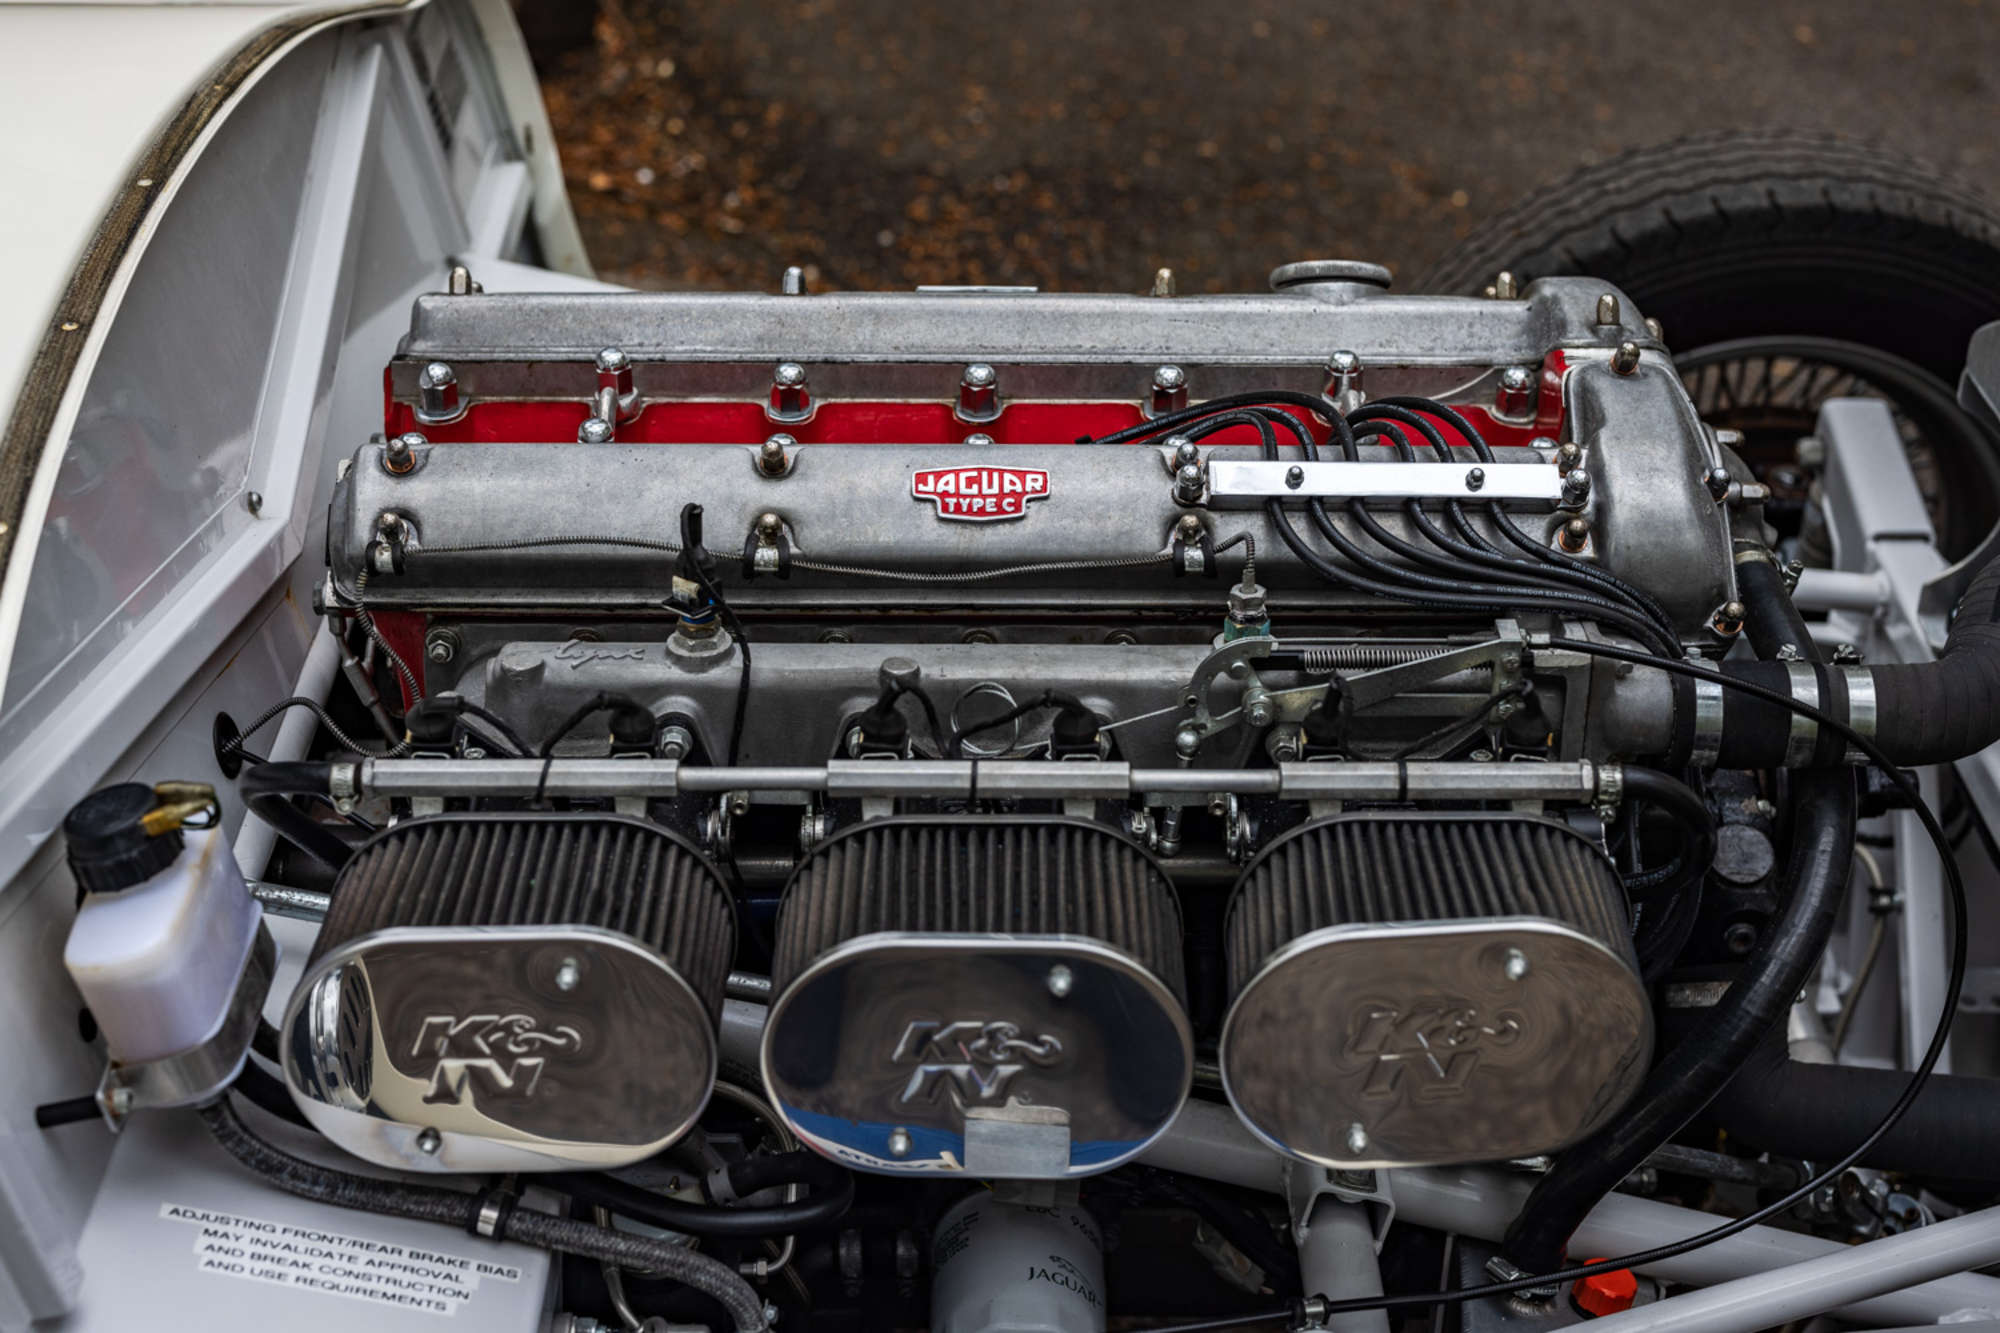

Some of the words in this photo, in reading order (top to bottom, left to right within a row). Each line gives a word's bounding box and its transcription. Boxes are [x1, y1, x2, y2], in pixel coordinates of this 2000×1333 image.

[917, 470, 1044, 496] JAGUAR
[944, 497, 998, 512] TYPE
[1002, 498, 1015, 511] C
[168, 1207, 276, 1234] ADJUSTING
[281, 1226, 403, 1257] FRONT/REAR
[408, 1250, 471, 1271] BRAKE
[476, 1262, 519, 1280] BIAS
[202, 1227, 245, 1243] MAY
[250, 1236, 359, 1265] INVALIDATE
[365, 1258, 465, 1285] APPROVAL
[203, 1243, 246, 1259] AND
[250, 1251, 313, 1271] BREAK
[318, 1264, 471, 1301] CONSTRUCTION
[203, 1259, 246, 1274] AND
[249, 1266, 290, 1282] USE
[294, 1275, 447, 1312] REQUIREMENTS
[1027, 1266, 1102, 1308] JAGUAR
